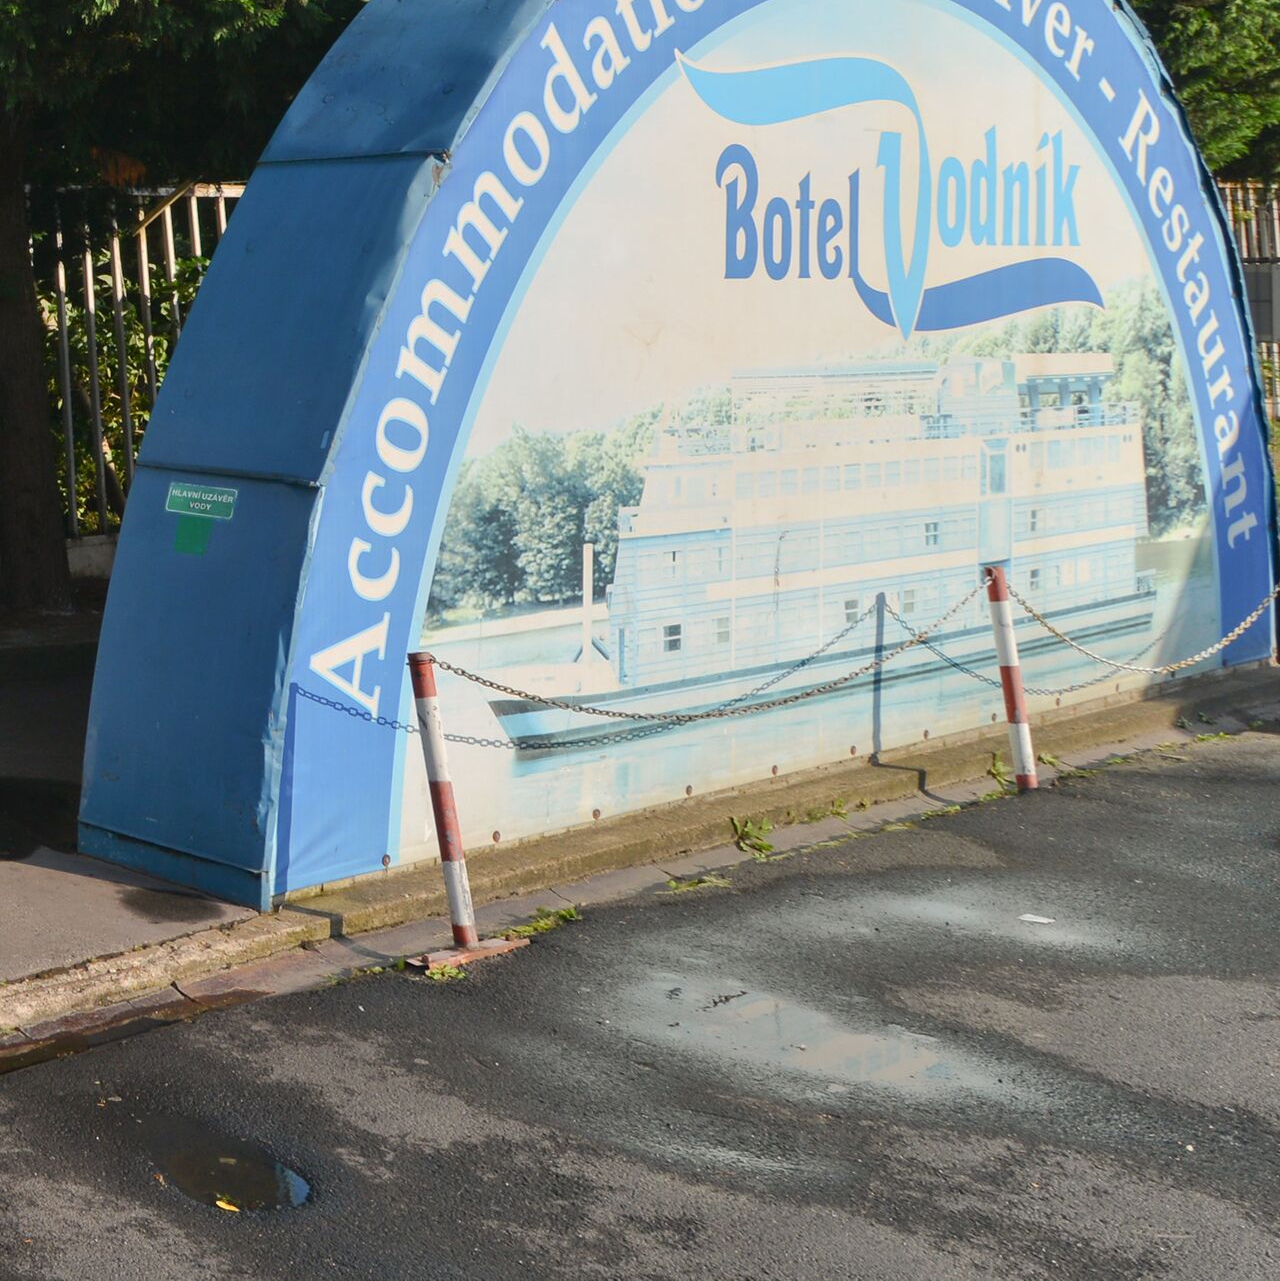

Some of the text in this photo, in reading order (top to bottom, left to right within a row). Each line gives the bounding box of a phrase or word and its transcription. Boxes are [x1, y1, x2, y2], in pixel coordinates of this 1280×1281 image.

[715, 124, 1081, 342] Botel Vodník
[1118, 88, 1259, 550] Restaurant
[171, 488, 201, 499] HLAVNÍ
[189, 501, 212, 511] VODY
